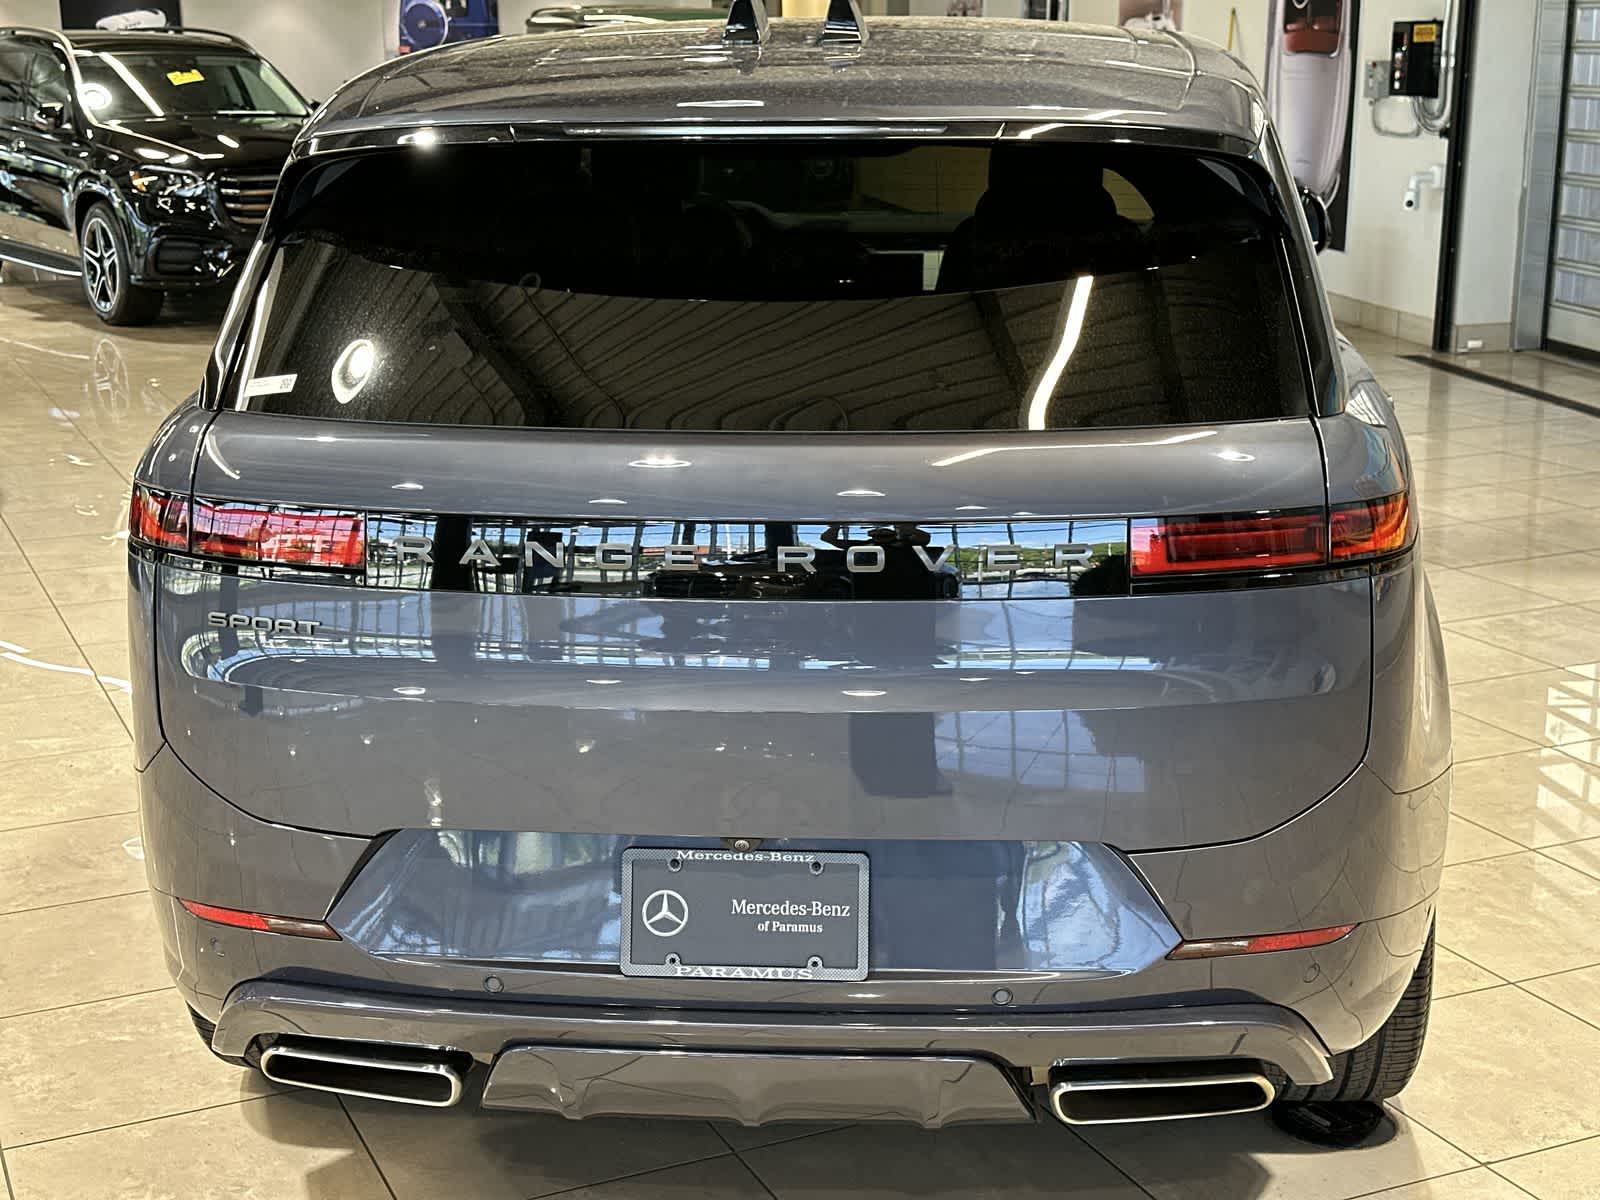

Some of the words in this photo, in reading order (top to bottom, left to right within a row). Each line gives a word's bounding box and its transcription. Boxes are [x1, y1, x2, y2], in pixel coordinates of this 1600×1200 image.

[393, 535, 699, 571] RANGE
[777, 544, 1094, 573] ROVER
[207, 611, 321, 635] SPORT
[676, 850, 815, 862] Mercedes-Benz
[731, 899, 850, 917] Mercedes-Benz
[757, 920, 770, 932] of
[772, 921, 823, 933] Paramus
[674, 967, 814, 980] PARAMUS
